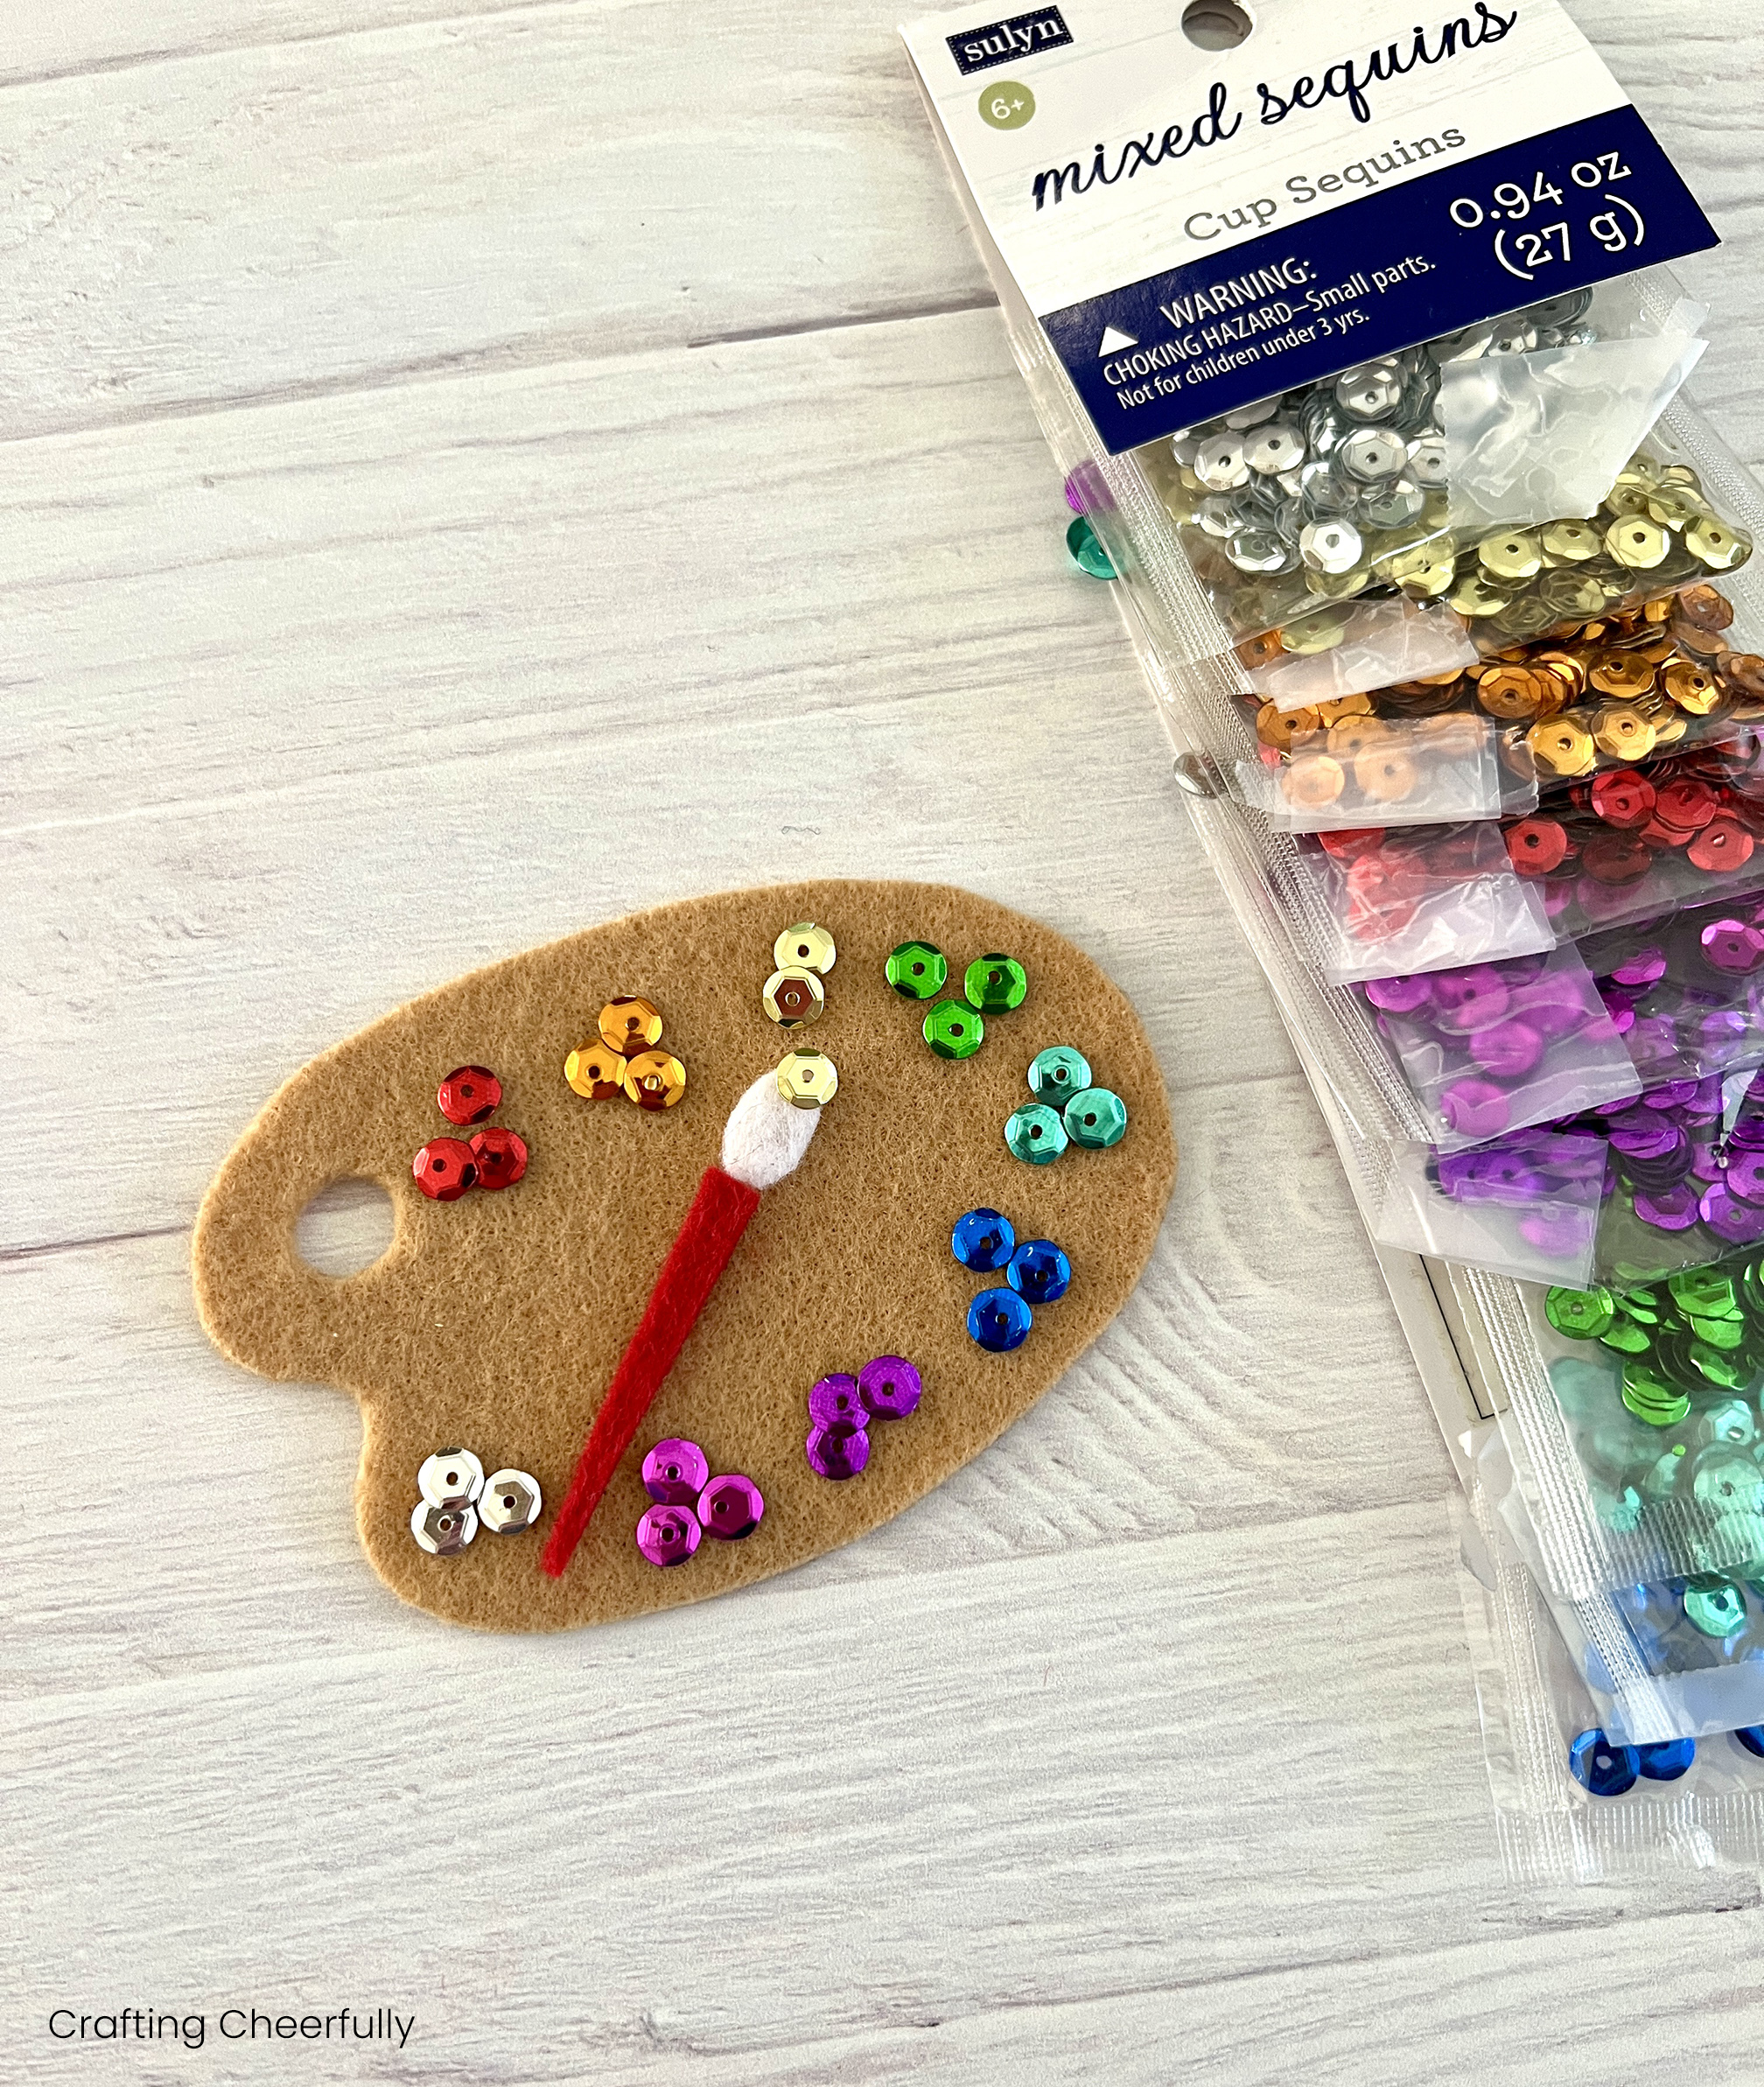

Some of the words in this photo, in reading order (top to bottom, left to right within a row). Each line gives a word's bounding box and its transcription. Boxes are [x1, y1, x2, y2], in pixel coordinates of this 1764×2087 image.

[963, 17, 1063, 62] sulyn
[990, 98, 1026, 120] 6+
[1032, 82, 1242, 212] mixed
[1256, 2, 1517, 125] sequins
[1184, 198, 1278, 242] Cup
[1285, 127, 1466, 206] Sequins
[1449, 172, 1564, 229] 0.94
[1571, 151, 1632, 189] oz
[1494, 222, 1572, 280] (27
[1589, 194, 1645, 252] g)
[1102, 334, 1202, 387] CHOKING
[1371, 255, 1437, 293] parts.
[1159, 257, 1317, 330] WARNING:
[1116, 384, 1155, 410] Not
[1154, 374, 1182, 396] for
[1186, 347, 1259, 385] children
[1261, 324, 1317, 357] under
[1317, 318, 1333, 336] 3
[1334, 308, 1370, 335] yrs.
